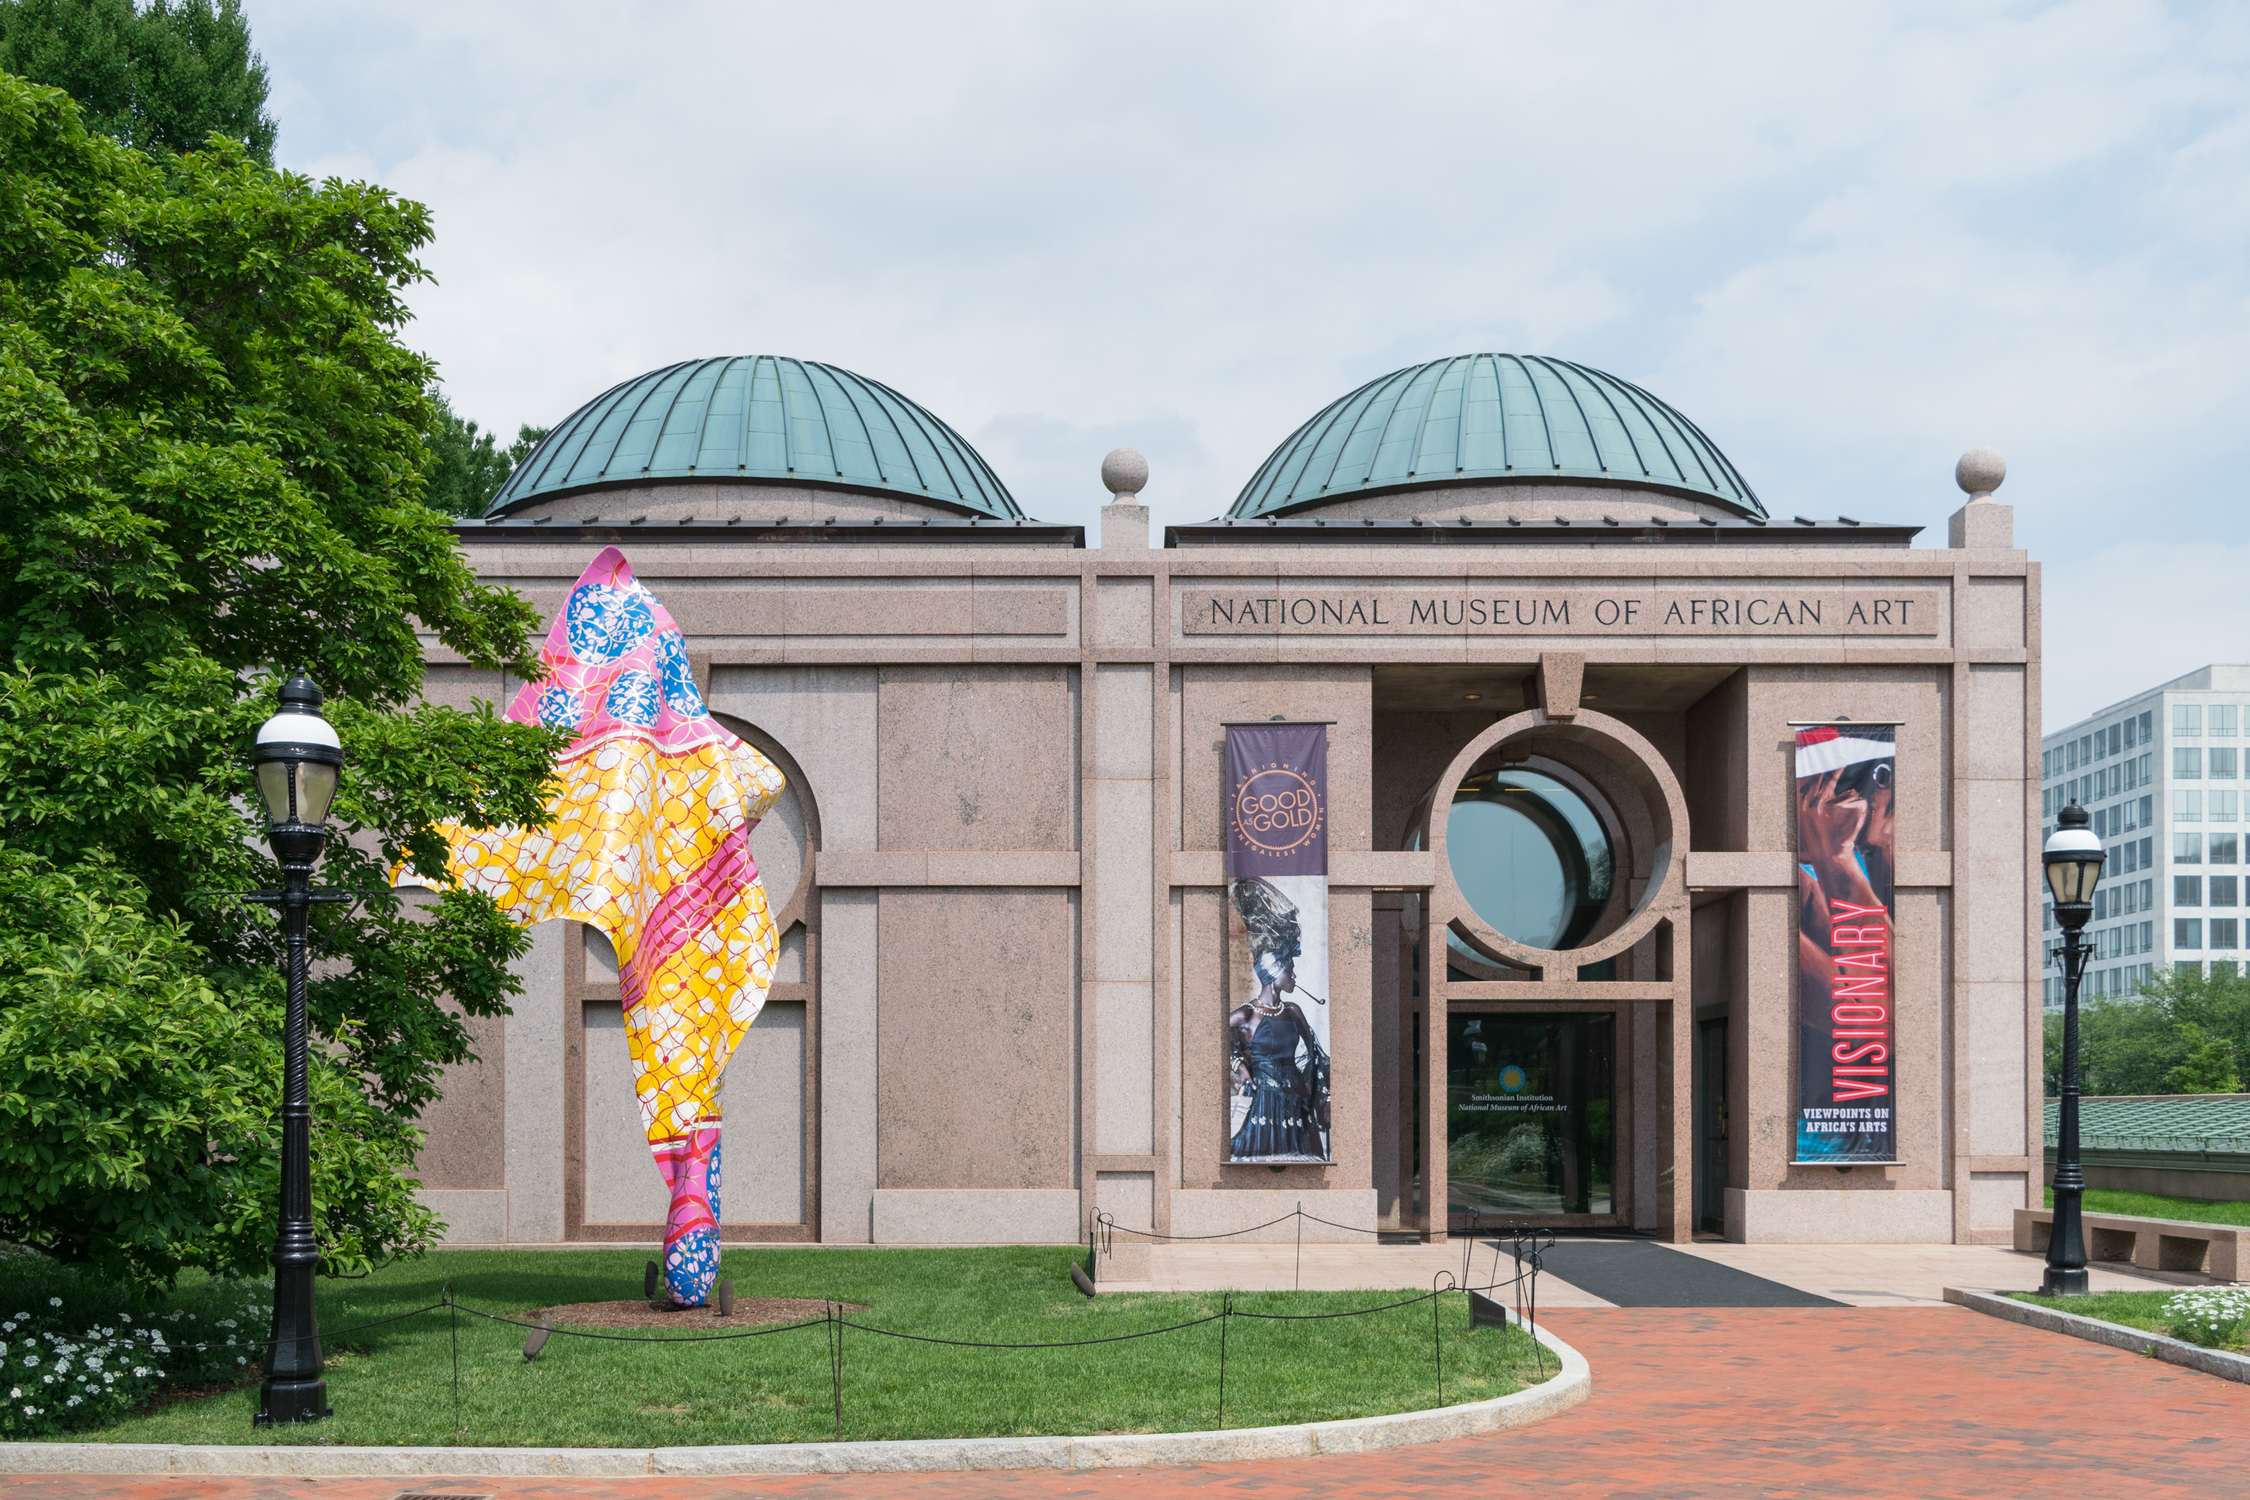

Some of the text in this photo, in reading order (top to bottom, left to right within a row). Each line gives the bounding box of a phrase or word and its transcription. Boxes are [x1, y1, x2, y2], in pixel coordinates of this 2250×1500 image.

[1211, 599, 1914, 626] NATIONAL MUSEUM OF AFRICAN ART
[1241, 789, 1311, 814] GOOD
[1243, 808, 1312, 832] AS GOLD
[1832, 898, 1889, 1102] VISIONARY
[1471, 1093, 1554, 1101] Smithsonian Institution
[1458, 1103, 1568, 1113] National Museum of African Art
[1803, 1108, 1889, 1119] VIEWPOINTS ON
[1806, 1122, 1887, 1132] AFRICA'S ARTS
